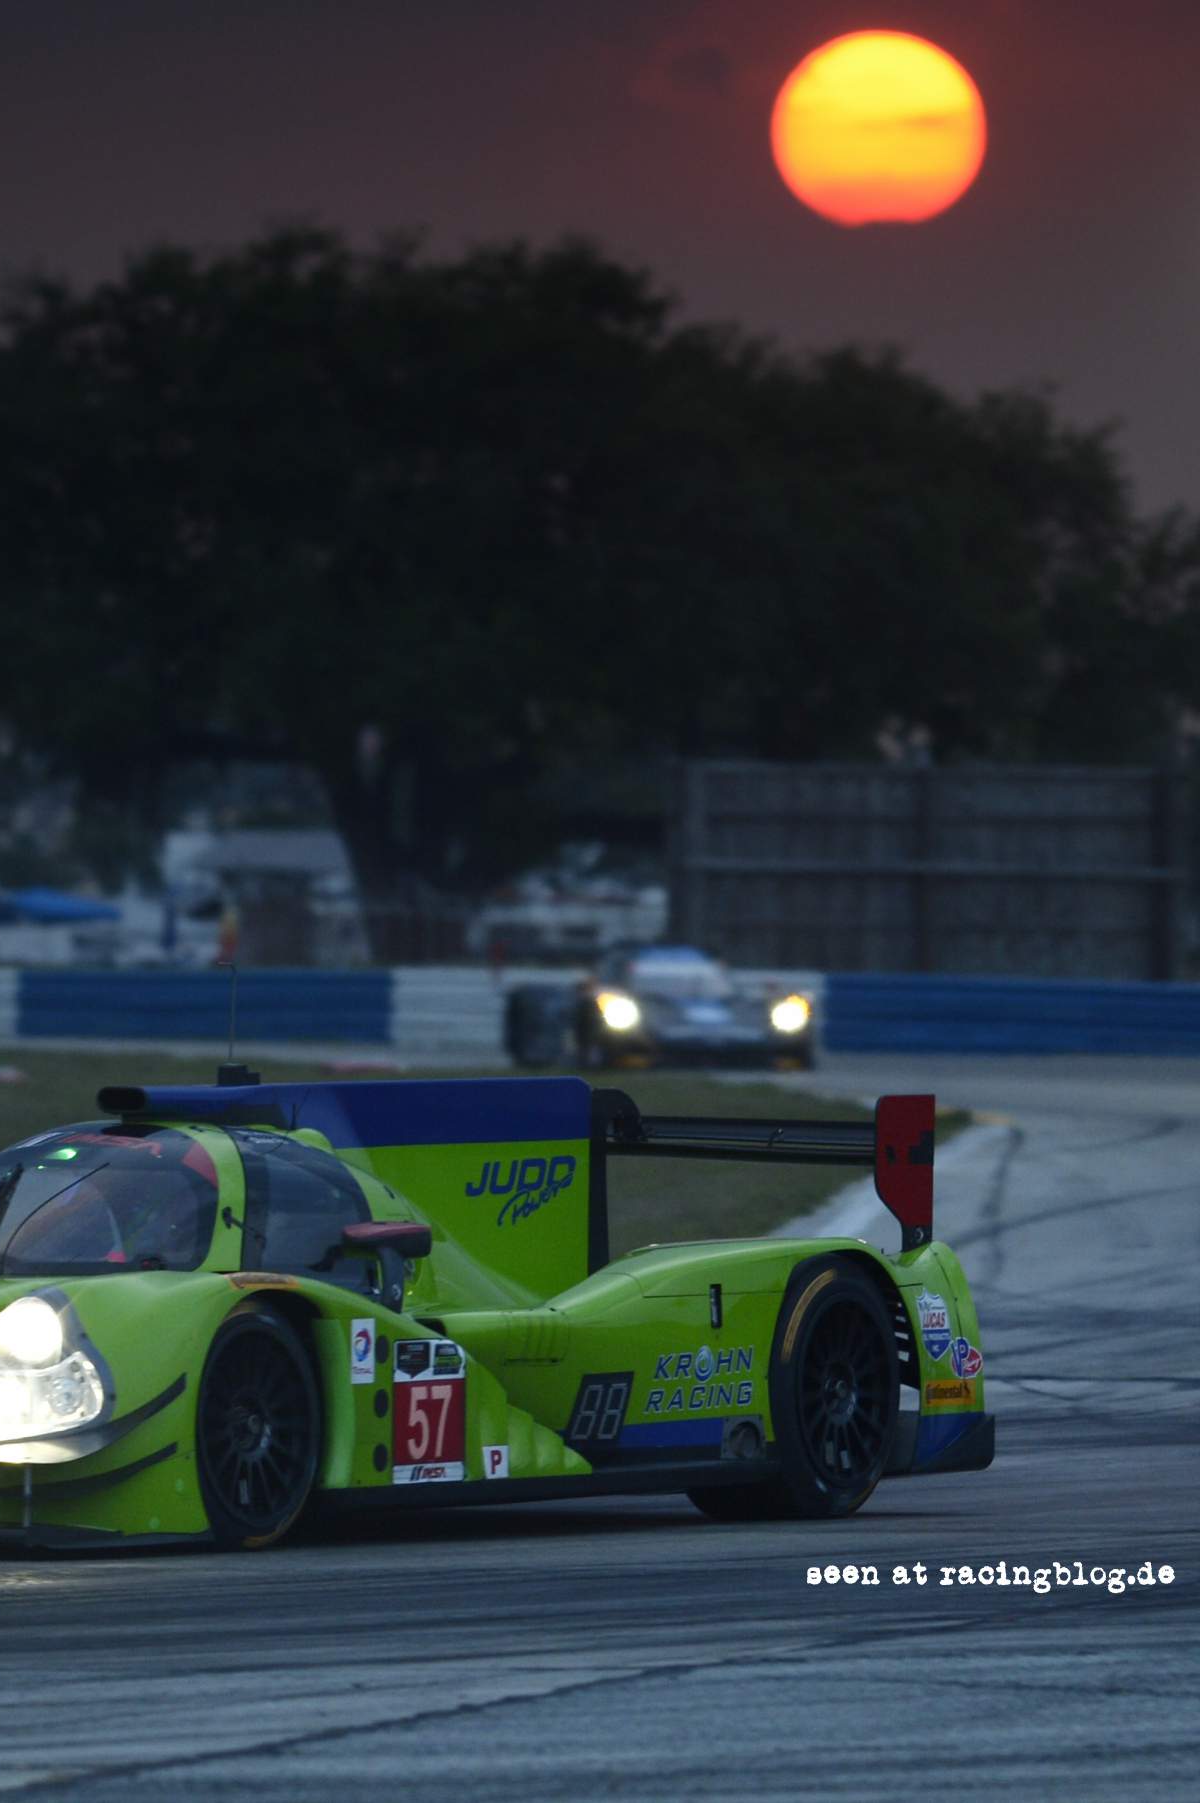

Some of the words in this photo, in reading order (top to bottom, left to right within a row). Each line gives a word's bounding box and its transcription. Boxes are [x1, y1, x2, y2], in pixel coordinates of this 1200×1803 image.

[465, 1155, 577, 1197] JUDD
[496, 1172, 575, 1227] Power
[922, 1311, 946, 1329] LUCAS
[652, 1345, 754, 1383] KROHN
[643, 1381, 753, 1413] RACING
[407, 1384, 453, 1461] 57
[490, 1450, 503, 1475] P
